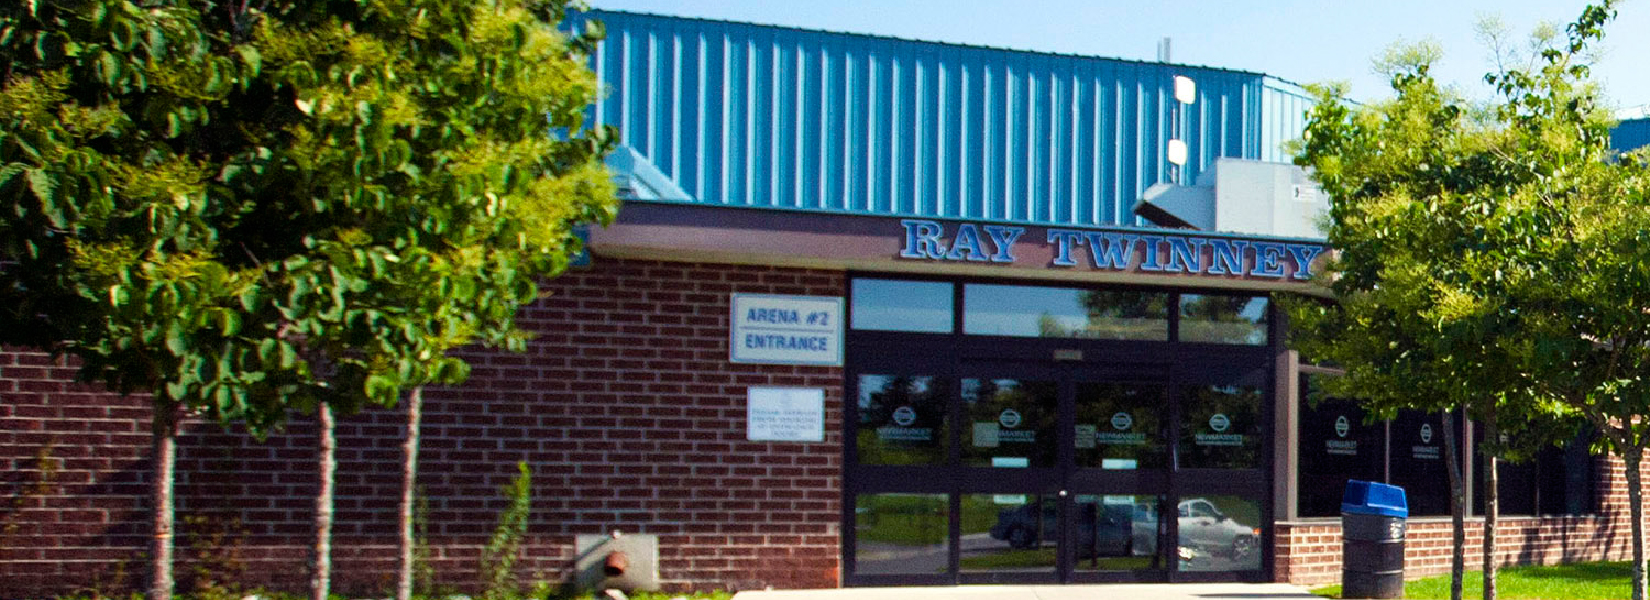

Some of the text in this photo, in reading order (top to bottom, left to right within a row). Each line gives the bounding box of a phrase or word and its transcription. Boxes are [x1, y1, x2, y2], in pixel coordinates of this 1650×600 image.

[901, 219, 1323, 280] RAY TWINNEY
[746, 308, 829, 326] ARENA #2
[745, 333, 828, 351] ENTRANCE
